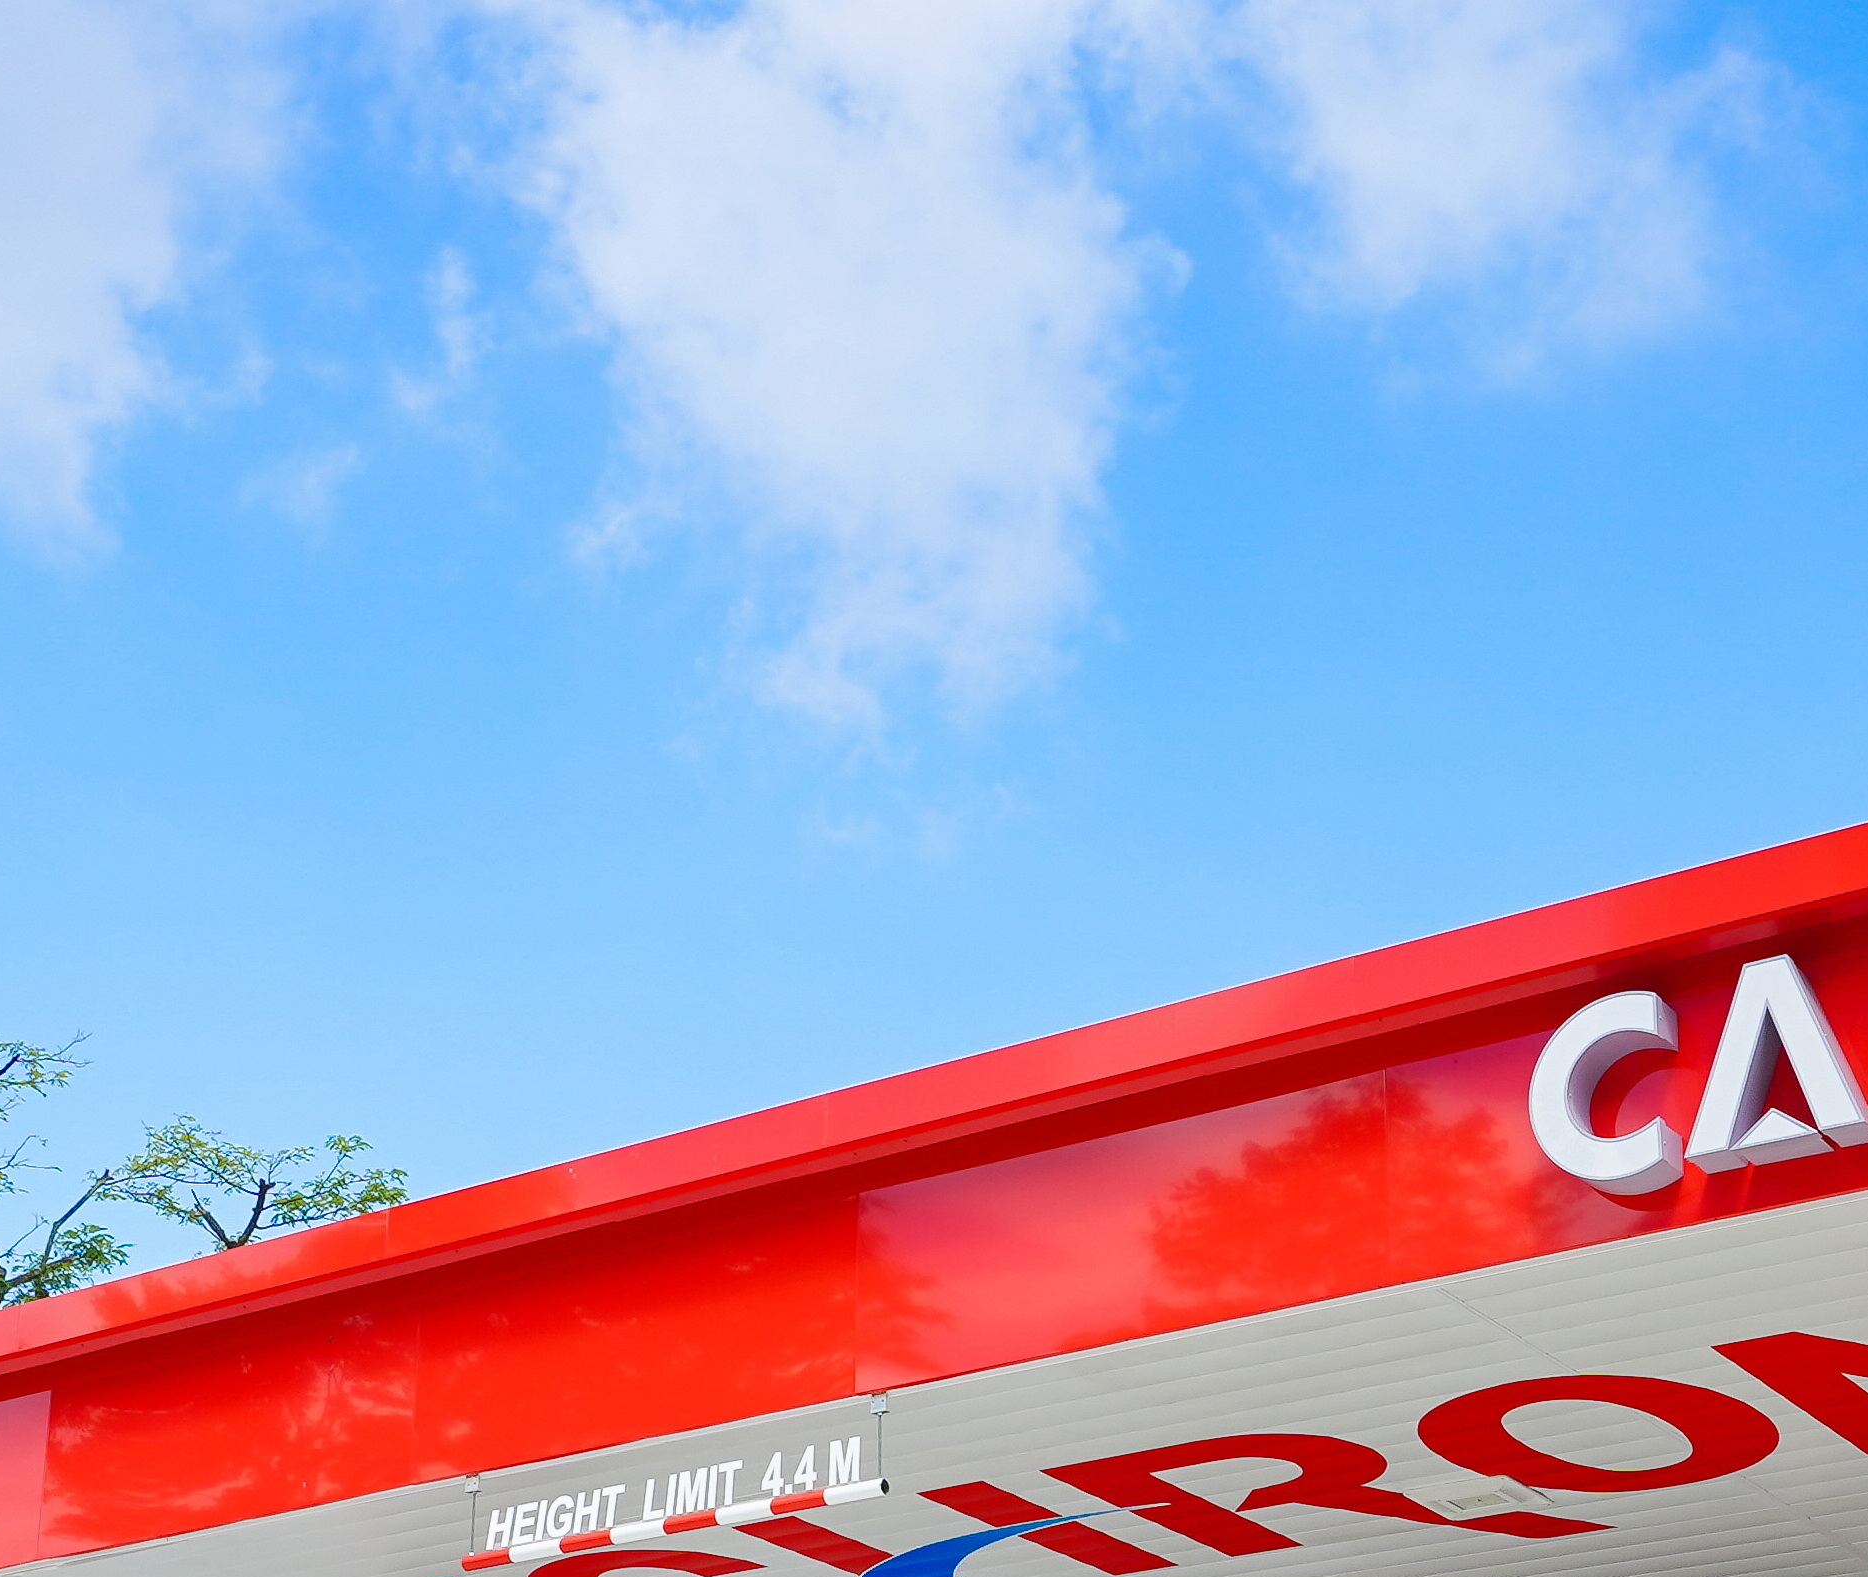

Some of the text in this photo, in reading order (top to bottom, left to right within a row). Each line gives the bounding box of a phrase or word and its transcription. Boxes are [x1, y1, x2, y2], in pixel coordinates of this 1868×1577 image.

[486, 1436, 862, 1551] HEIGHT LIMIT 4.4 M
